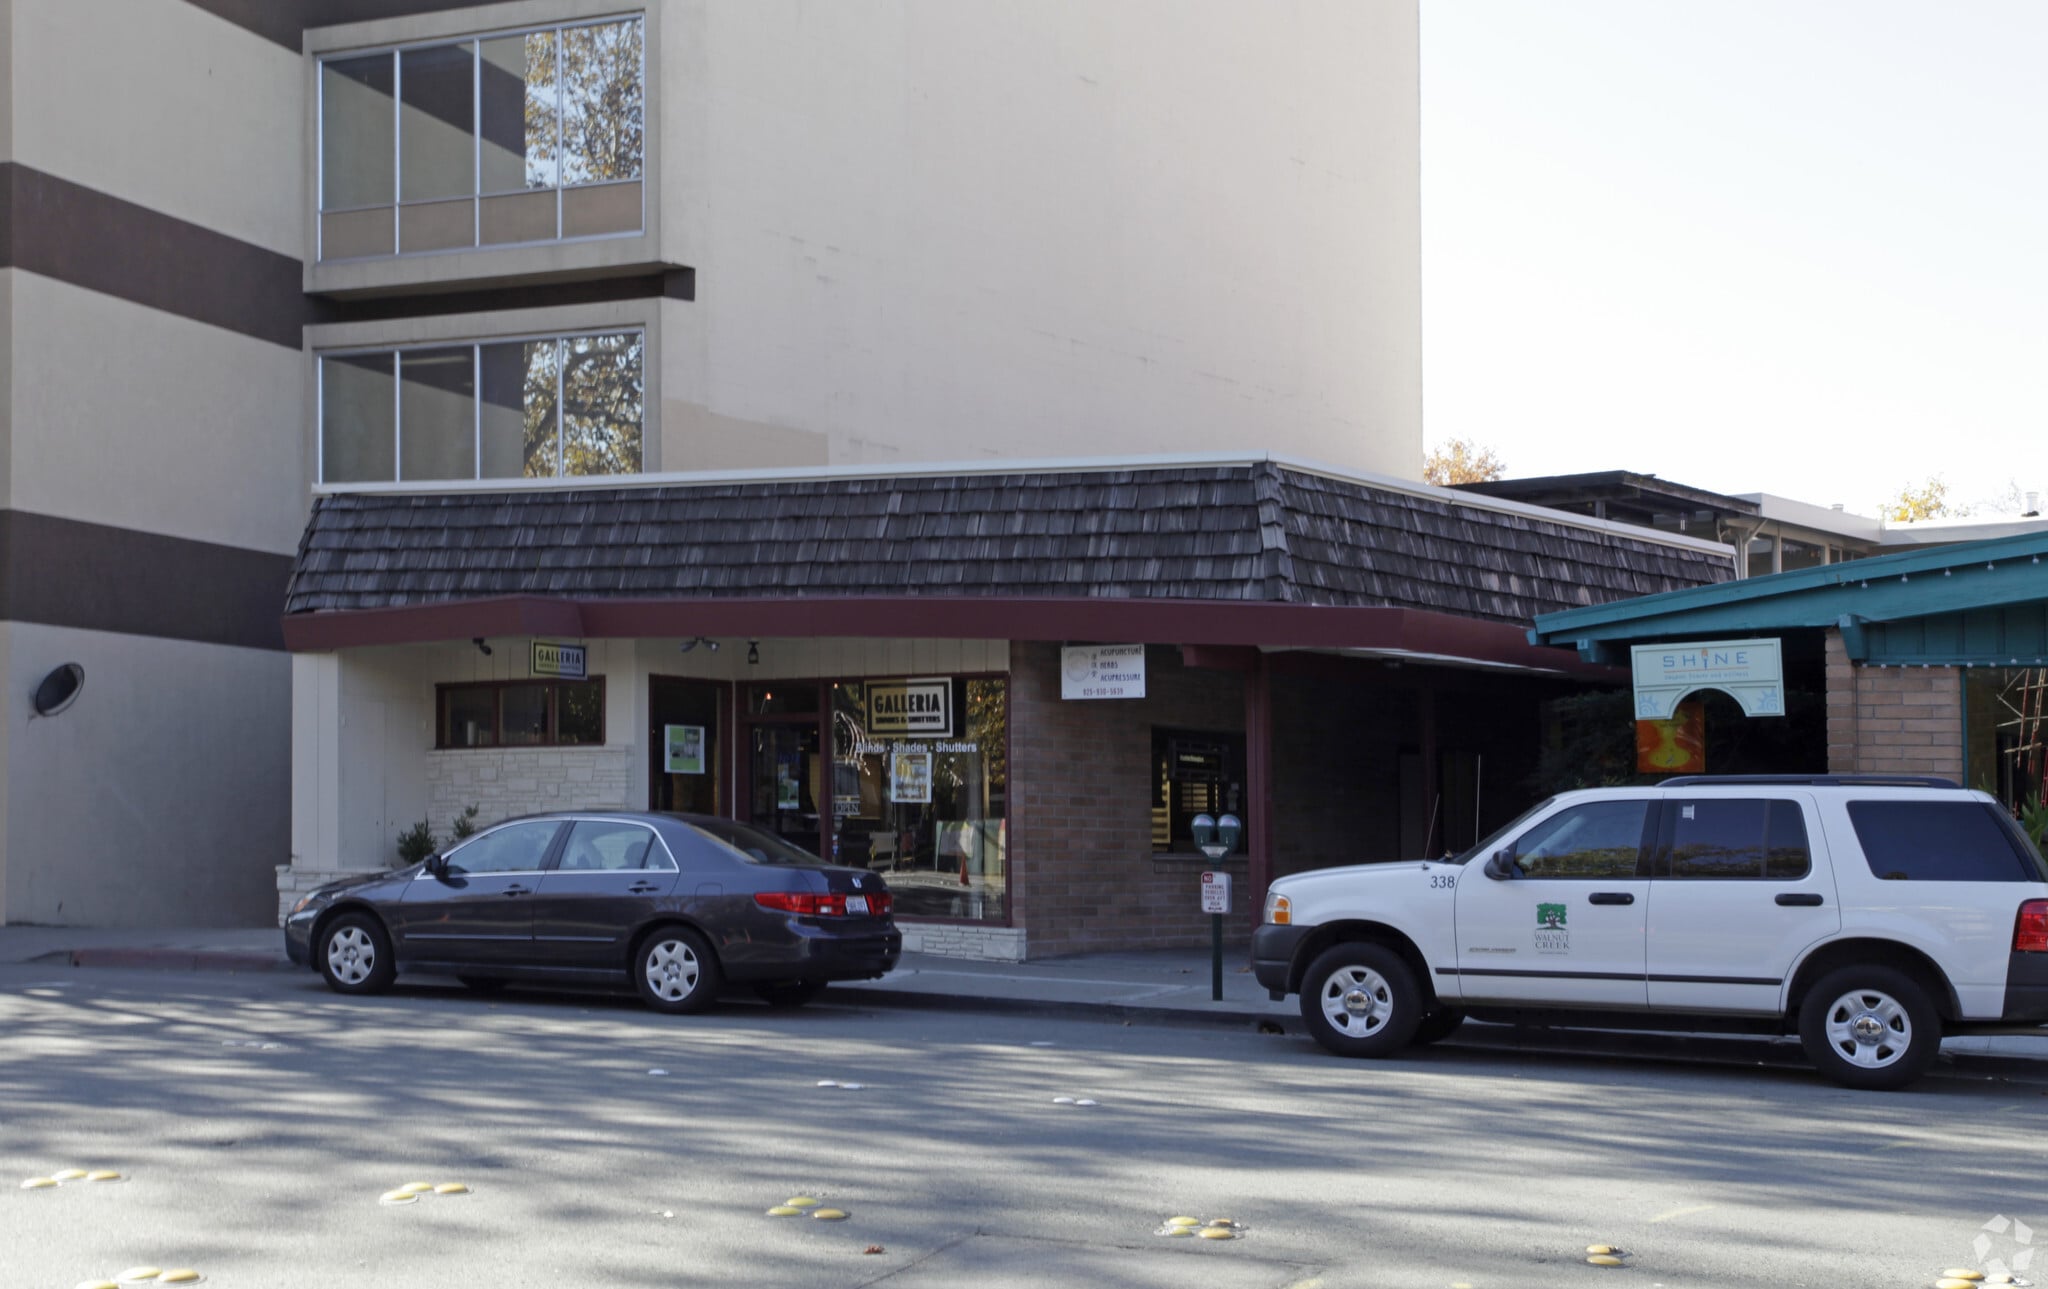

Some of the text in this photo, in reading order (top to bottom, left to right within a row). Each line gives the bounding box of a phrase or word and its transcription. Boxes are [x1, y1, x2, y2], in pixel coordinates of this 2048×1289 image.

[538, 649, 581, 664] GALLERIA
[1100, 646, 1142, 656] ACUPUNCTURE
[1663, 649, 1748, 670] SHINE
[1101, 673, 1141, 682] ACUPRESSURE
[874, 694, 941, 713] GALLERIA
[855, 742, 977, 753] Blinds Shades Shutters
[1430, 876, 1455, 889] 338
[1535, 934, 1569, 942] WALNUT
[1535, 941, 1570, 949] CREEK
